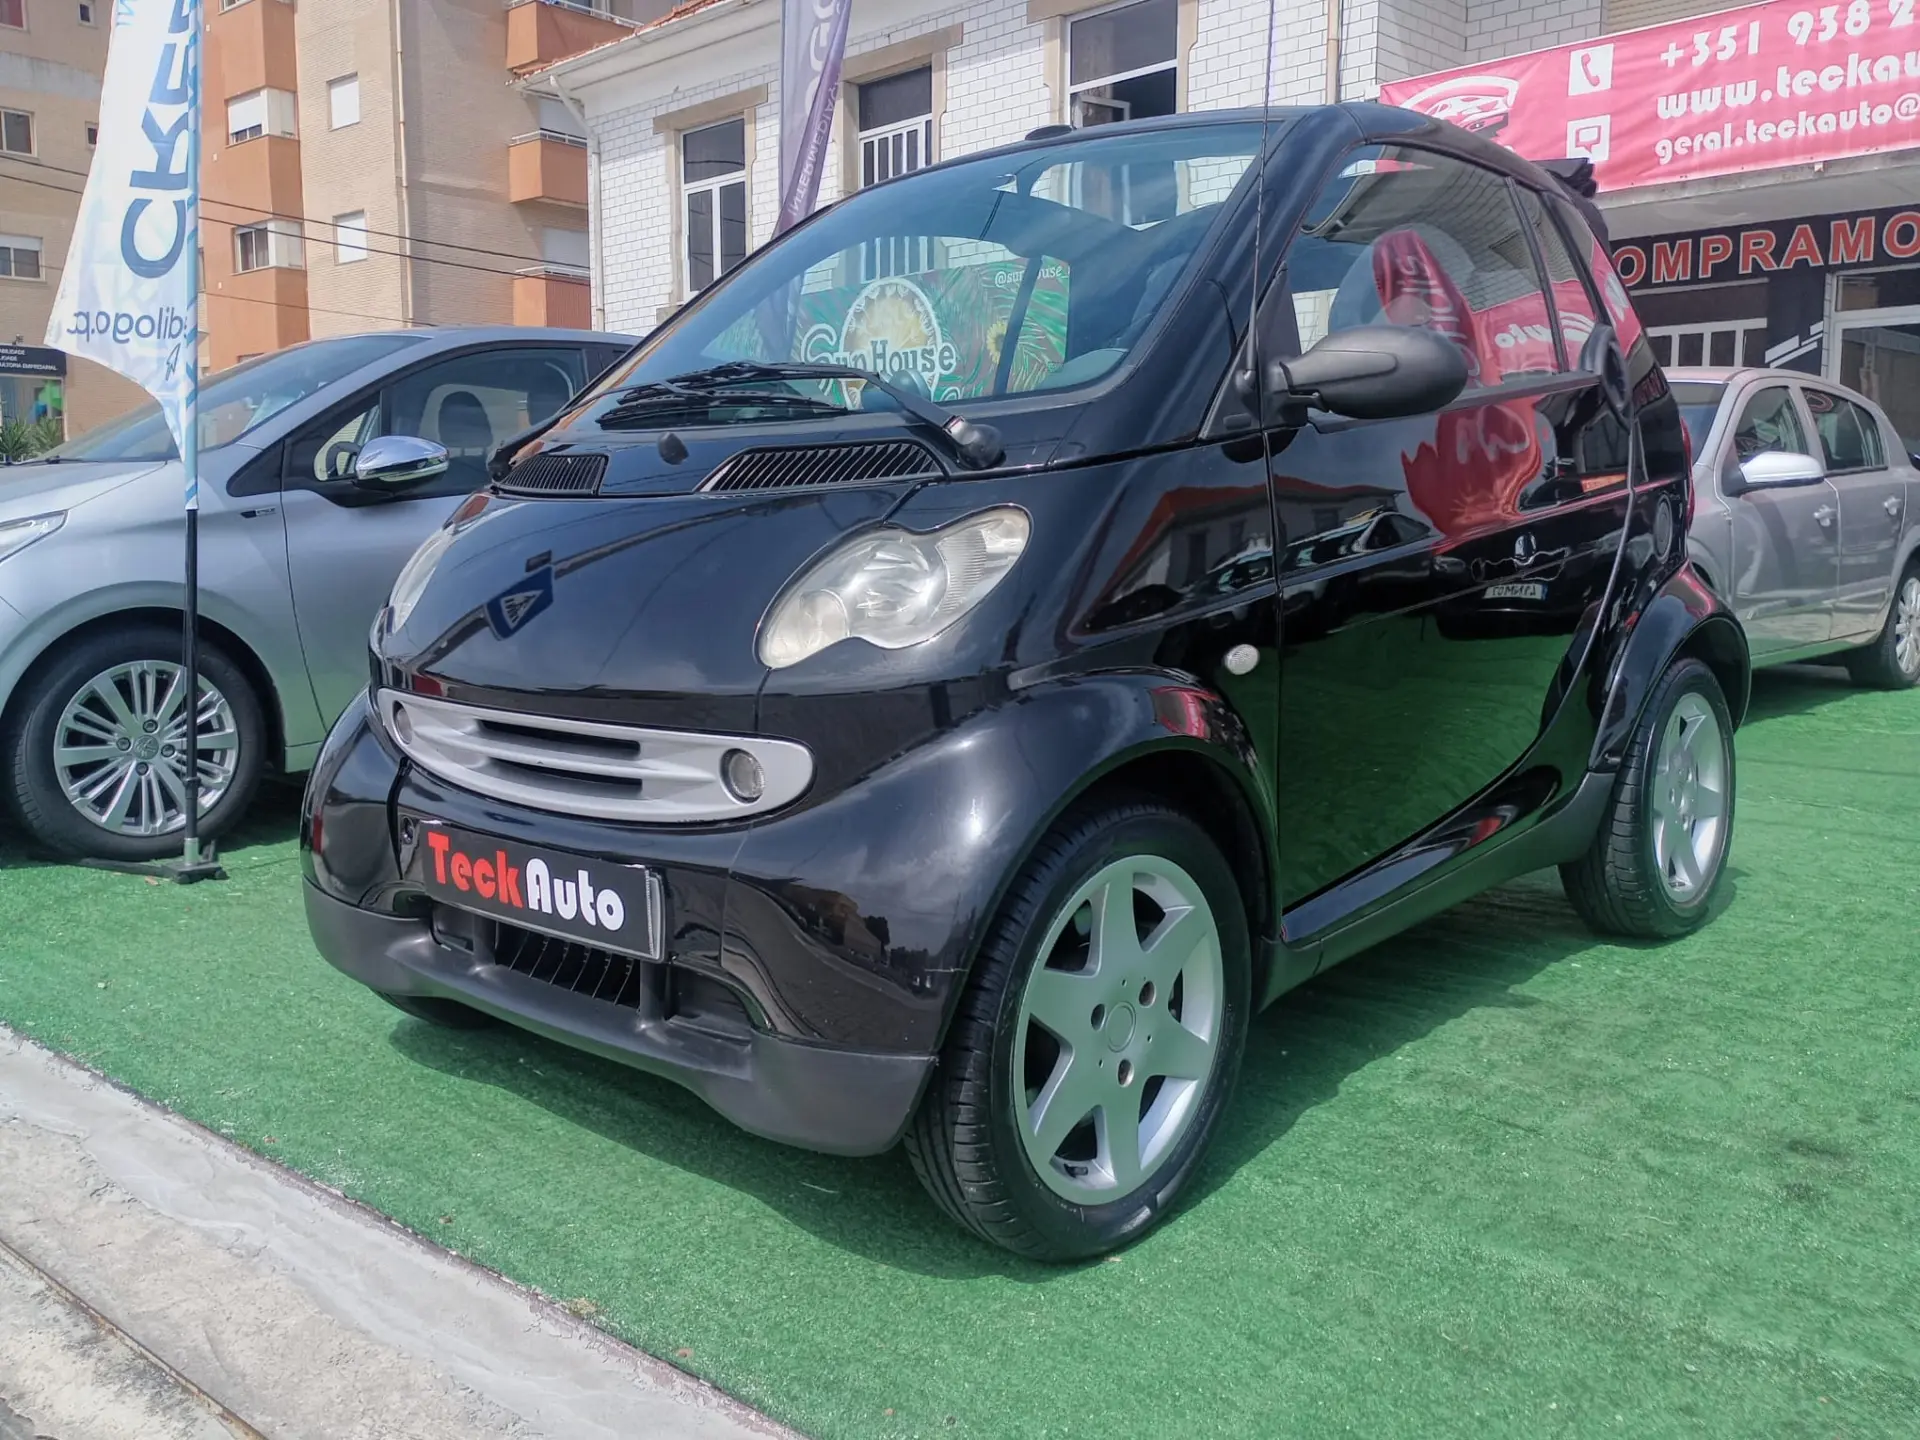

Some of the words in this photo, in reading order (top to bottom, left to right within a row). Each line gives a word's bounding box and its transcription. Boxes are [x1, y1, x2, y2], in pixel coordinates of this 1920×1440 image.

[1660, 21, 1760, 67] +351
[1787, 0, 1870, 45] 938
[1611, 211, 1920, 287] OMPRAMO
[428, 831, 625, 931] TeckAuto
